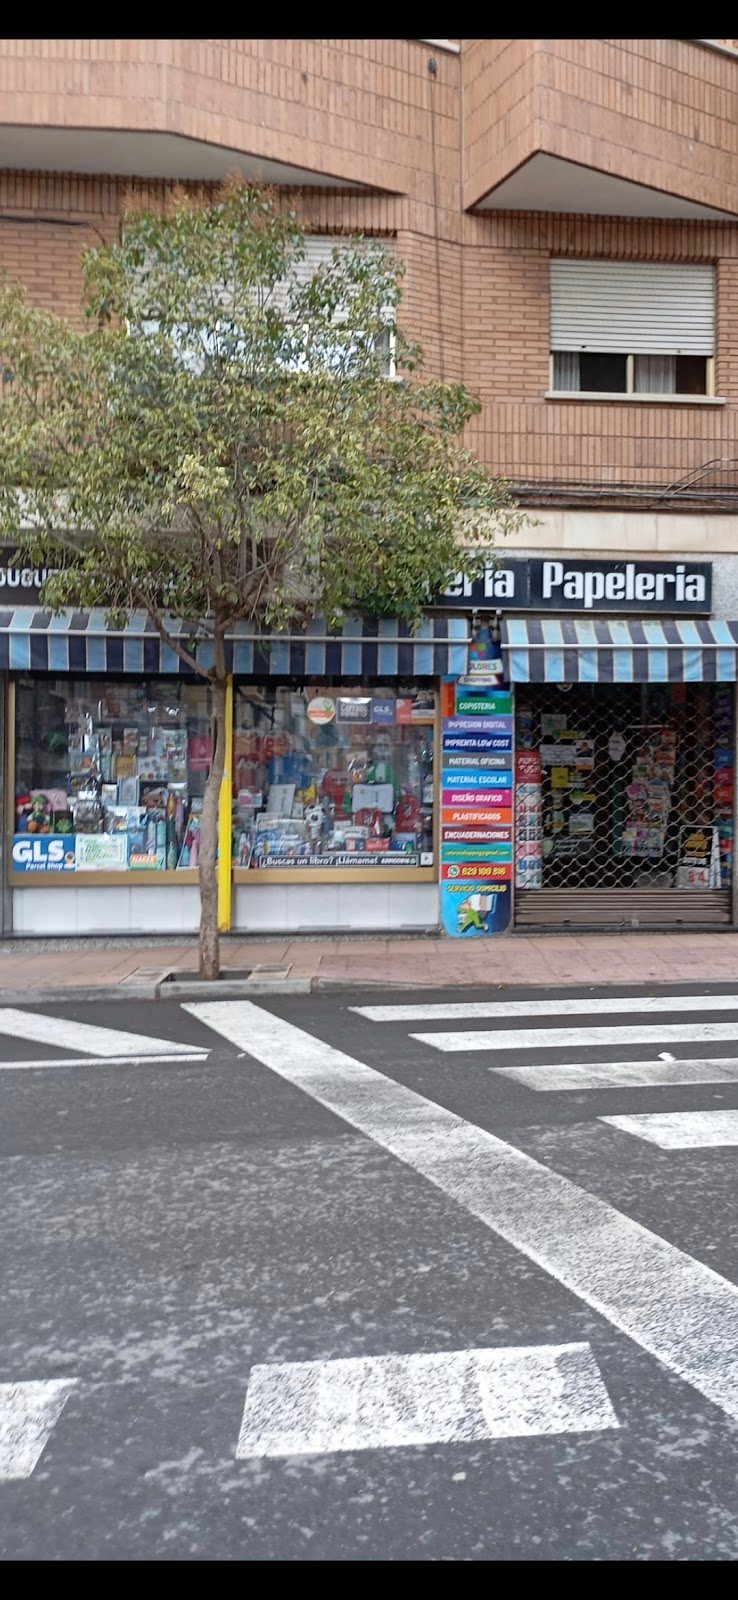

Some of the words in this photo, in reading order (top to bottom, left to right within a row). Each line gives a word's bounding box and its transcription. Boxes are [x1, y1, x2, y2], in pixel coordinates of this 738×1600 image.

[542, 562, 706, 608] Papeleria
[477, 739, 492, 747] LOW
[493, 739, 509, 747] COST
[12, 840, 64, 863] GLS
[298, 858, 308, 866] un
